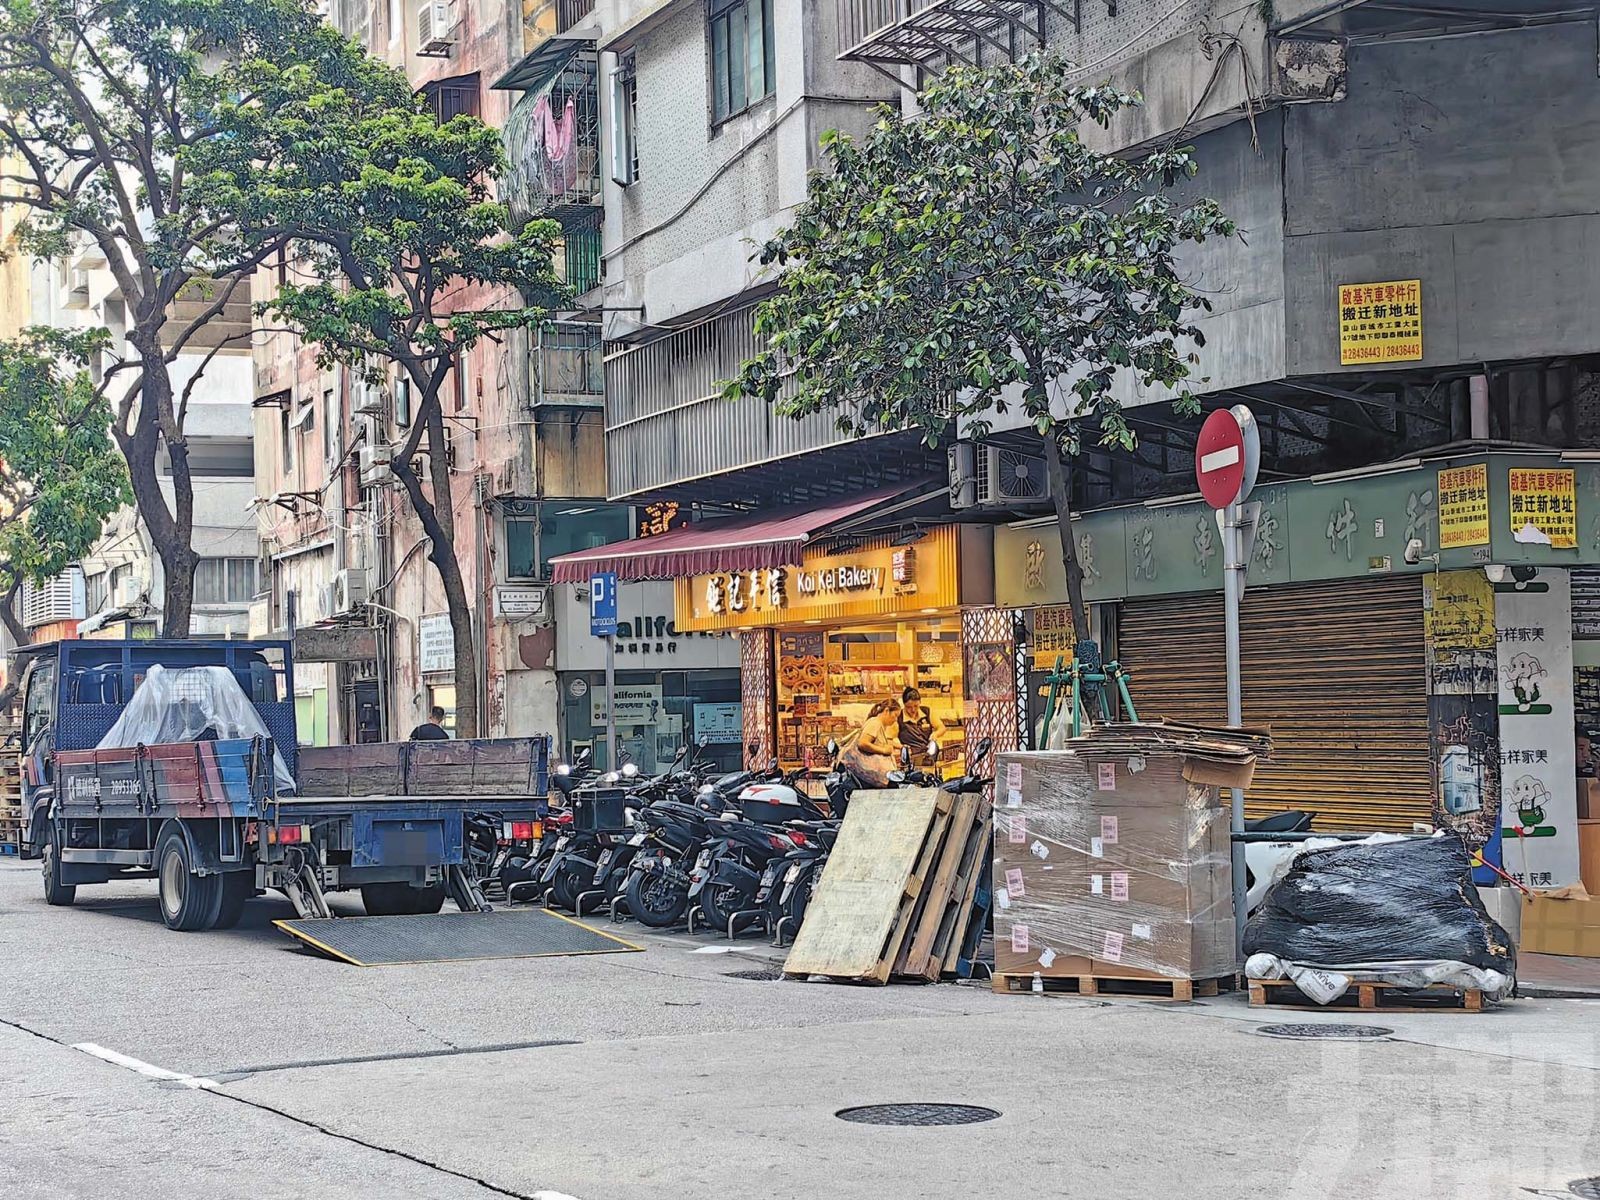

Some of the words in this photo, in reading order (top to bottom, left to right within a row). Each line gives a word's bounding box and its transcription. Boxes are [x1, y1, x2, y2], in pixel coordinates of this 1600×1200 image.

[1342, 302, 1419, 320] 搬迁新地址
[1440, 486, 1486, 505] 搬迁新地址
[1512, 494, 1573, 513] 搬迁新地址
[797, 572, 815, 594] Koi
[817, 569, 836, 590] Kei
[838, 566, 881, 592] Bakery
[592, 578, 604, 617] P
[1035, 608, 1073, 631] 啟基汽車零
[614, 690, 653, 700] alifornia
